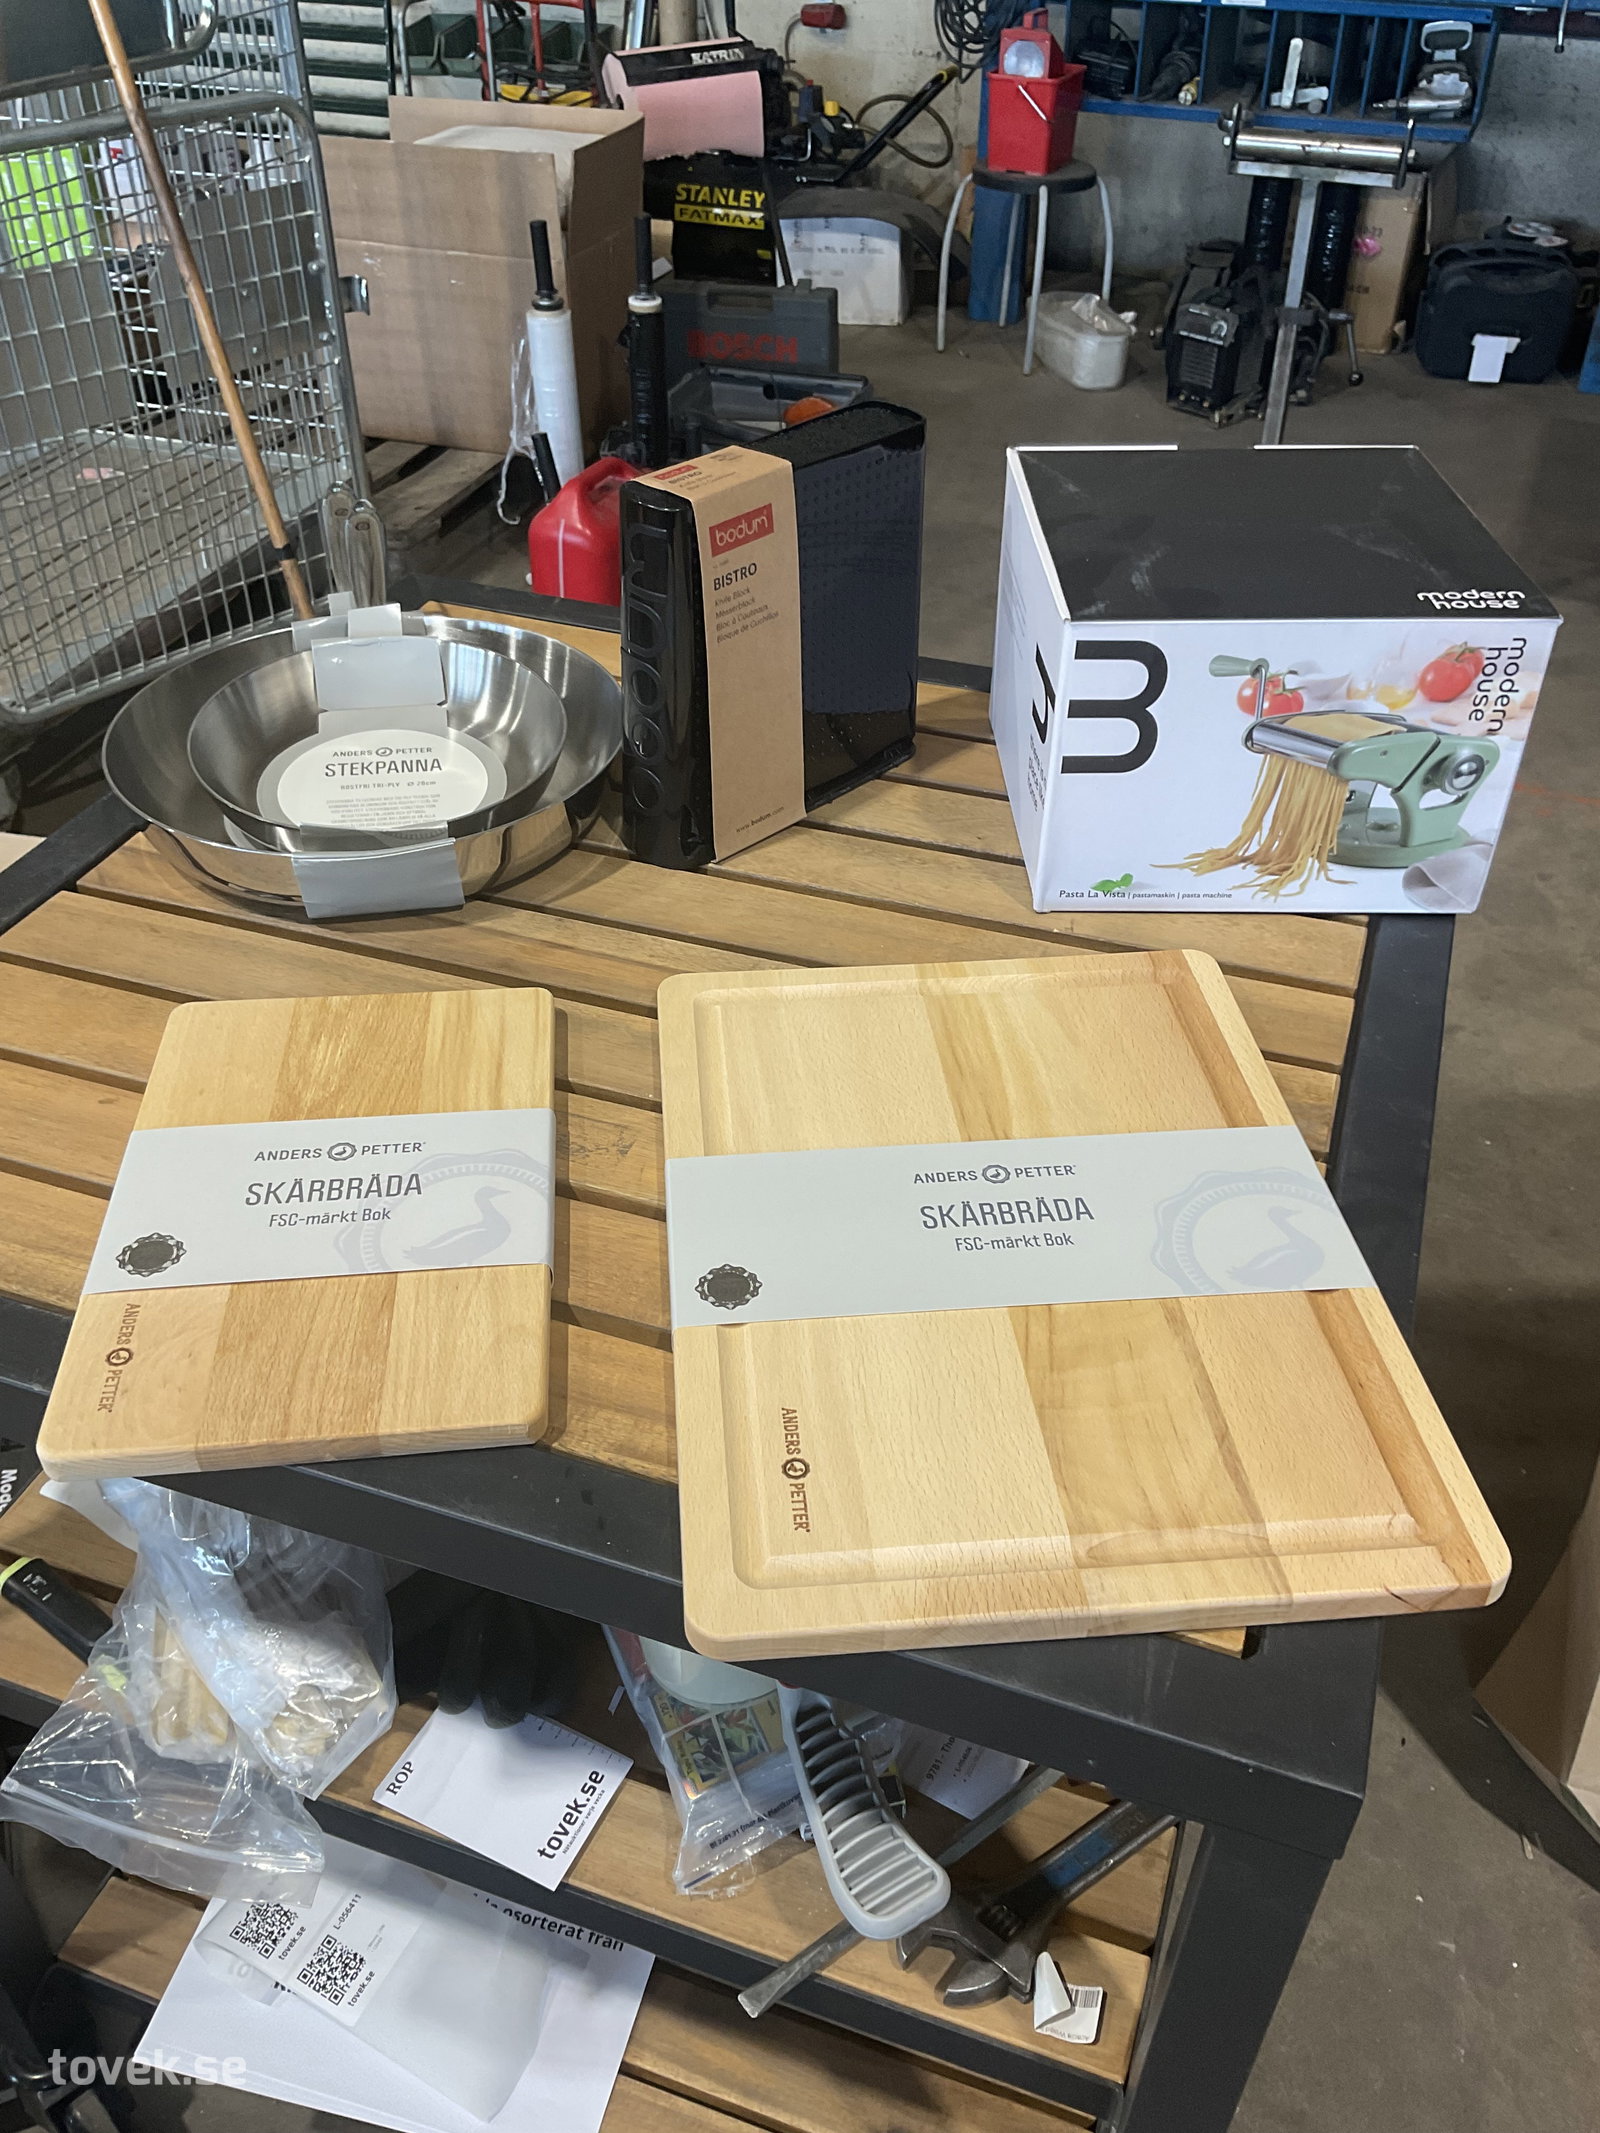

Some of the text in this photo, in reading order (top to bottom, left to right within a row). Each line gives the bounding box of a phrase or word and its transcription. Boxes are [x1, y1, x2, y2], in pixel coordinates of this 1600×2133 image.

[675, 183, 765, 208] STANLEY
[679, 208, 760, 226] FATMAX
[687, 330, 798, 363] BOSCH
[716, 515, 769, 546] bodum
[713, 563, 757, 591] BISTRO
[1417, 589, 1525, 601] modern
[1432, 599, 1520, 609] house
[1468, 647, 1508, 721] house
[1487, 638, 1527, 732] modern
[396, 747, 432, 755] PETTER
[325, 758, 442, 777] STEKPANNA
[1059, 890, 1085, 898] Pasta
[1088, 890, 1098, 898] La
[1103, 890, 1126, 898] Vista
[254, 1148, 322, 1161] ANDERS
[245, 1173, 422, 1206] SKÄRBRÄDA
[913, 1170, 978, 1184] ANDERS
[269, 1207, 391, 1228] FSC-märkt Bok
[920, 1197, 1095, 1229] SKÄRBRÄDA
[955, 1232, 1075, 1251] FSC-märkt Bok
[116, 1303, 141, 1345] ANDERS
[781, 1407, 801, 1455] ANDERS
[386, 1760, 414, 1796] ROP
[537, 1770, 605, 1859] tovek.se
[278, 1926, 307, 1961] tovek.se
[347, 1970, 375, 2007] tovek.se
